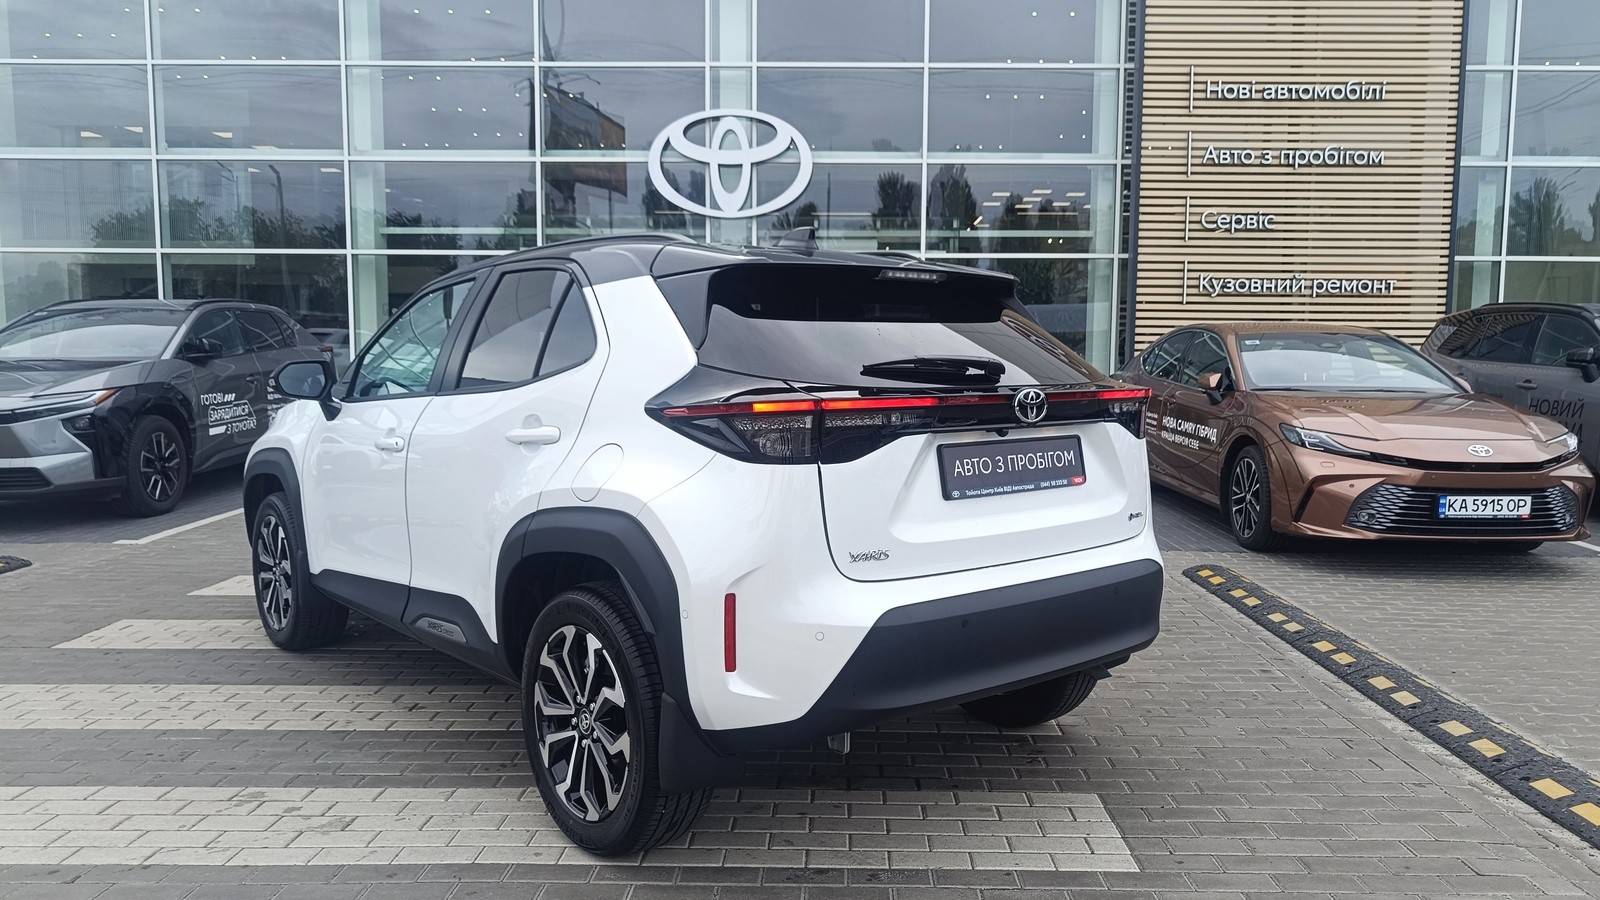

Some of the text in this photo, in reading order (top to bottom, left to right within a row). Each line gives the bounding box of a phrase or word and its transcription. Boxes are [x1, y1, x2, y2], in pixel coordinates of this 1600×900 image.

[1206, 79, 1388, 101] Нові автомобілі
[1202, 145, 1385, 170] Авто з пробігом
[1200, 210, 1277, 234] Сервіс
[1198, 273, 1398, 297] Кузовний ремонт
[1529, 398, 1585, 420] НОВИЙ
[1162, 416, 1177, 428] НОВА
[1196, 424, 1217, 443] ГІБРИД
[954, 450, 1076, 477] АВТО З ПРОБІГОМ
[1448, 498, 1527, 513] KA 5915 OP
[848, 549, 890, 563] YARIS
